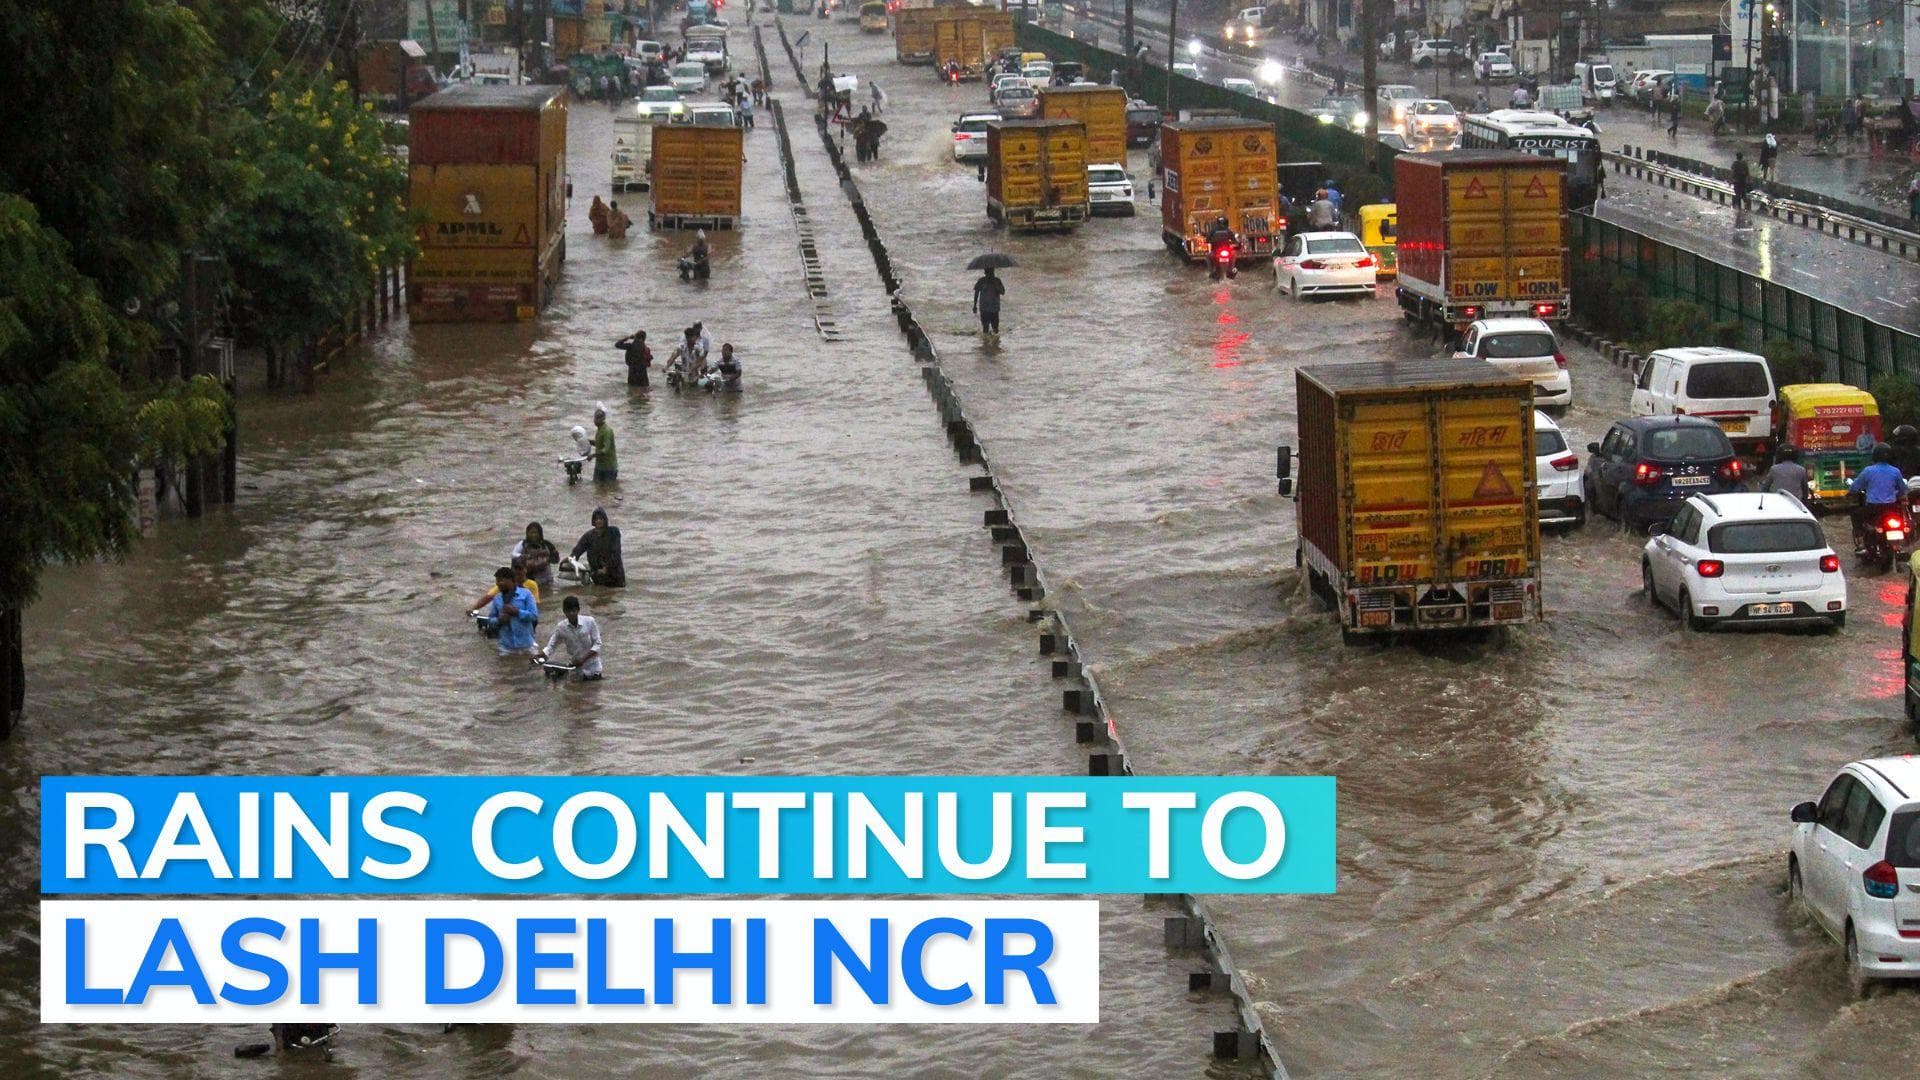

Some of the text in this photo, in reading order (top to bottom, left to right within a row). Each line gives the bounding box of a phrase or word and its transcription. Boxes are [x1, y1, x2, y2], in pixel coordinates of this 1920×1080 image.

[1737, 12, 1760, 20] TAA
[1515, 139, 1589, 150] TOURIST
[1243, 217, 1269, 233] HORN
[1454, 281, 1559, 296] BLOW HORN
[1360, 558, 1521, 582] BLOW HORN
